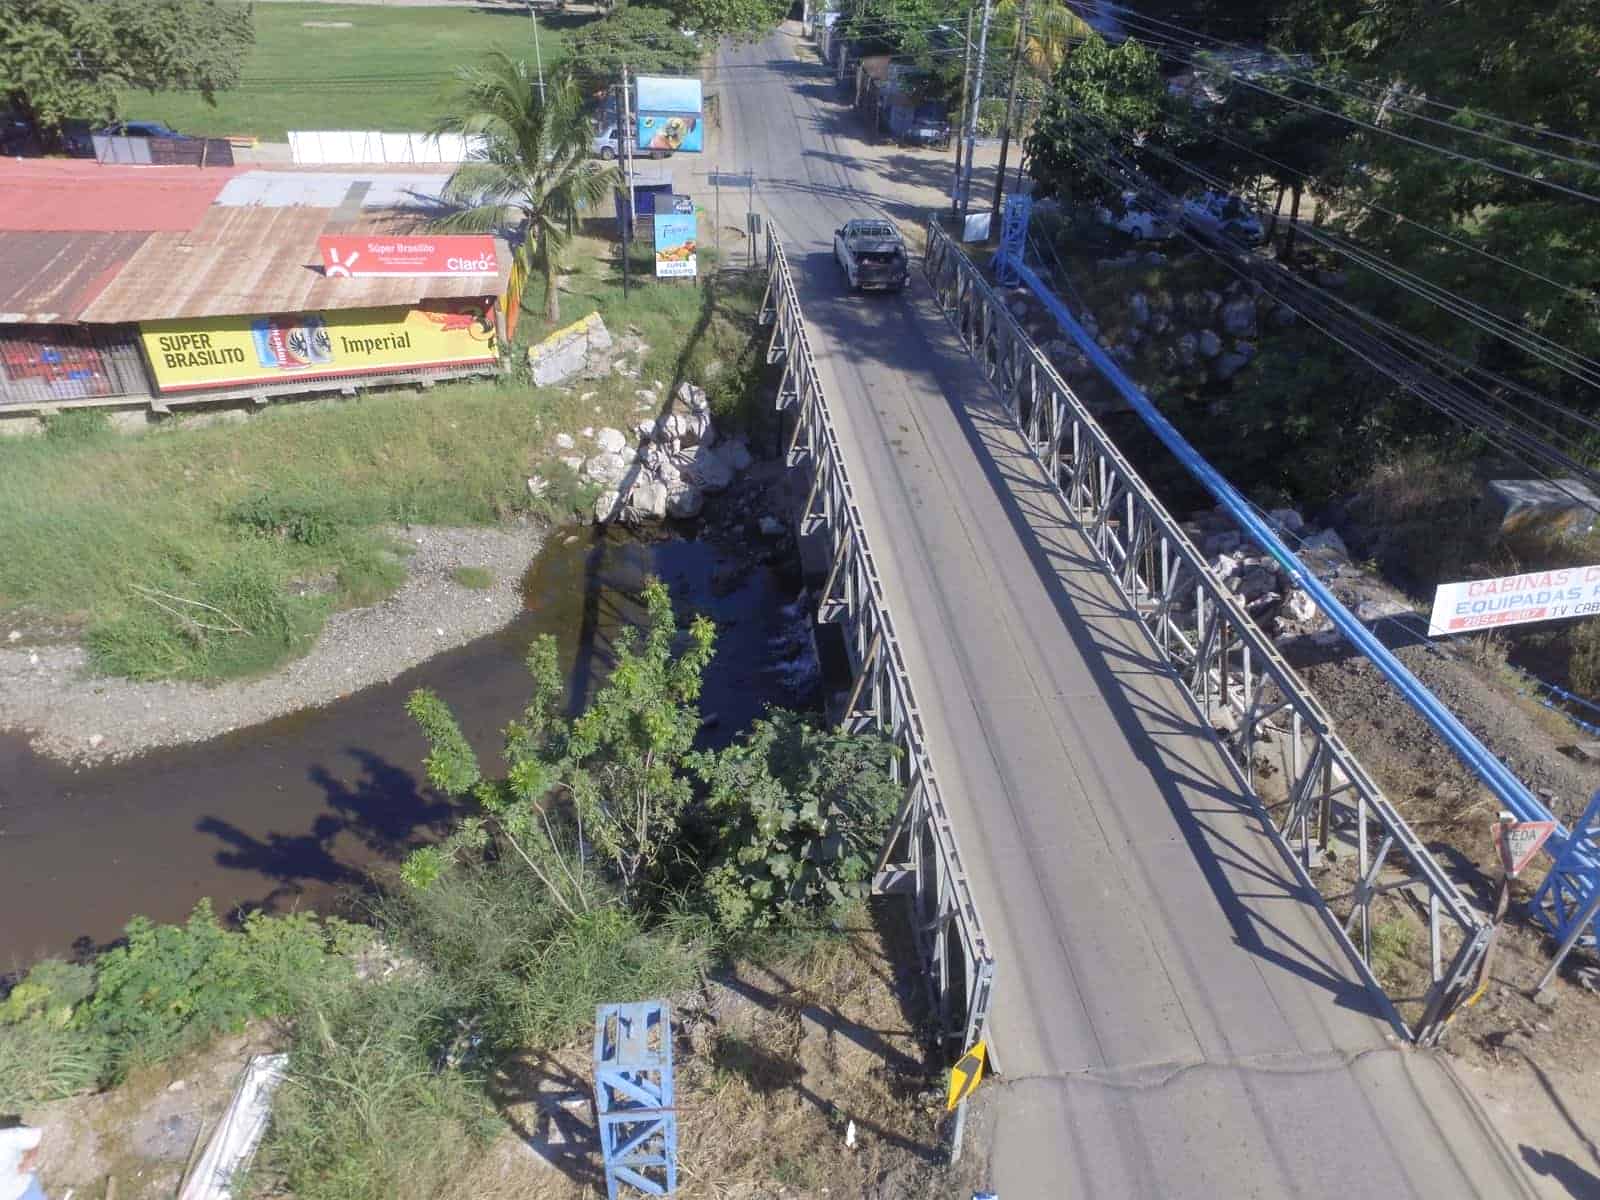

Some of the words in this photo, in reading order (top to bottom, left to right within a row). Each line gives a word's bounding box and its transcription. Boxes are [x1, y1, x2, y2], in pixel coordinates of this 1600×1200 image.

[447, 255, 492, 271] Claro
[160, 334, 212, 351] SUPER
[341, 331, 412, 354] Imperial
[165, 348, 245, 368] BRASILITO
[1468, 571, 1569, 597] CABINAS
[1456, 587, 1583, 614] EQUIPADAS
[1552, 604, 1568, 617] TV
